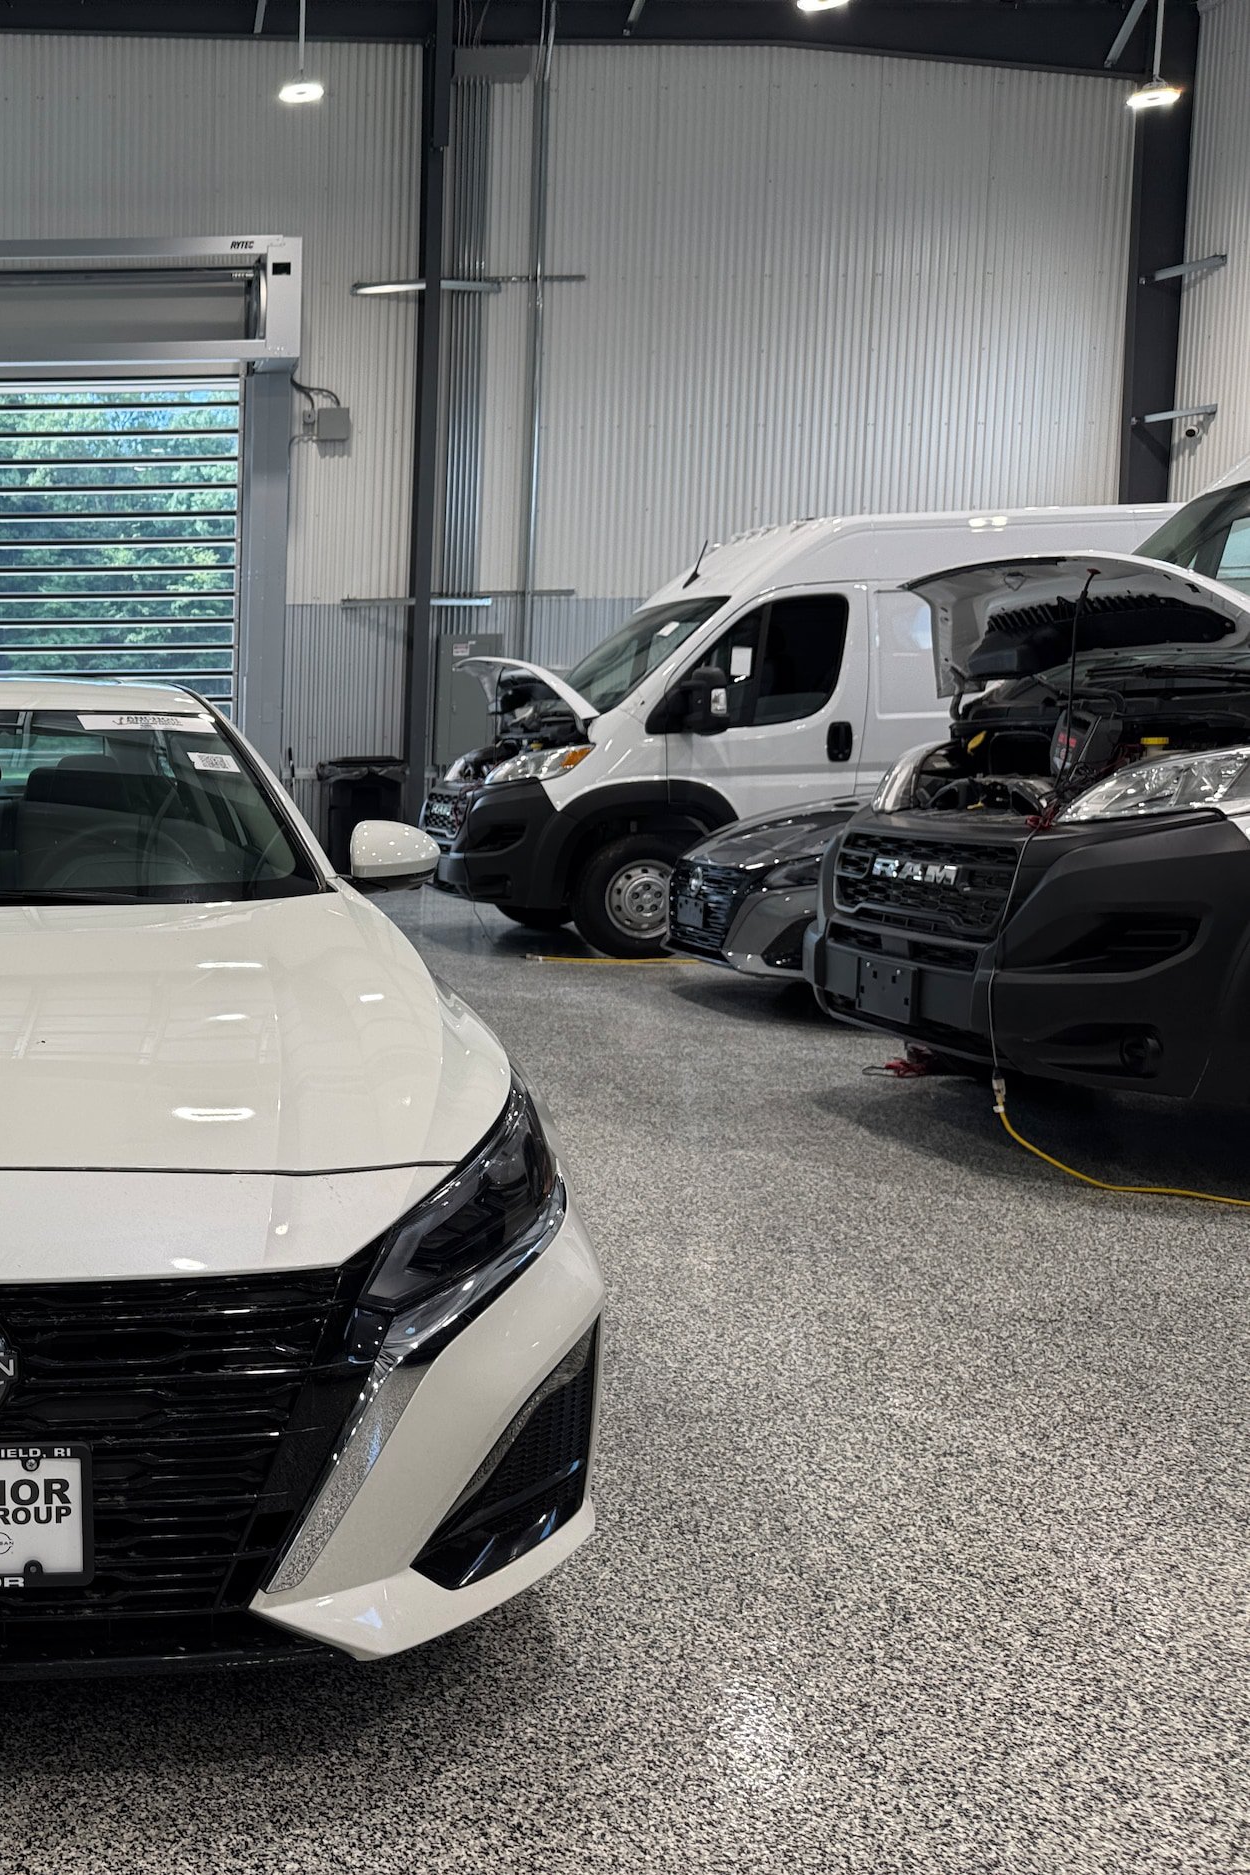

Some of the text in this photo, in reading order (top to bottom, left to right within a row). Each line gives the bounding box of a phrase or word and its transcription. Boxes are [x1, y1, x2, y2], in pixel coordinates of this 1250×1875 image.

[230, 241, 254, 249] RYTEC
[872, 858, 958, 885] RAM
[53, 1447, 71, 1457] RI
